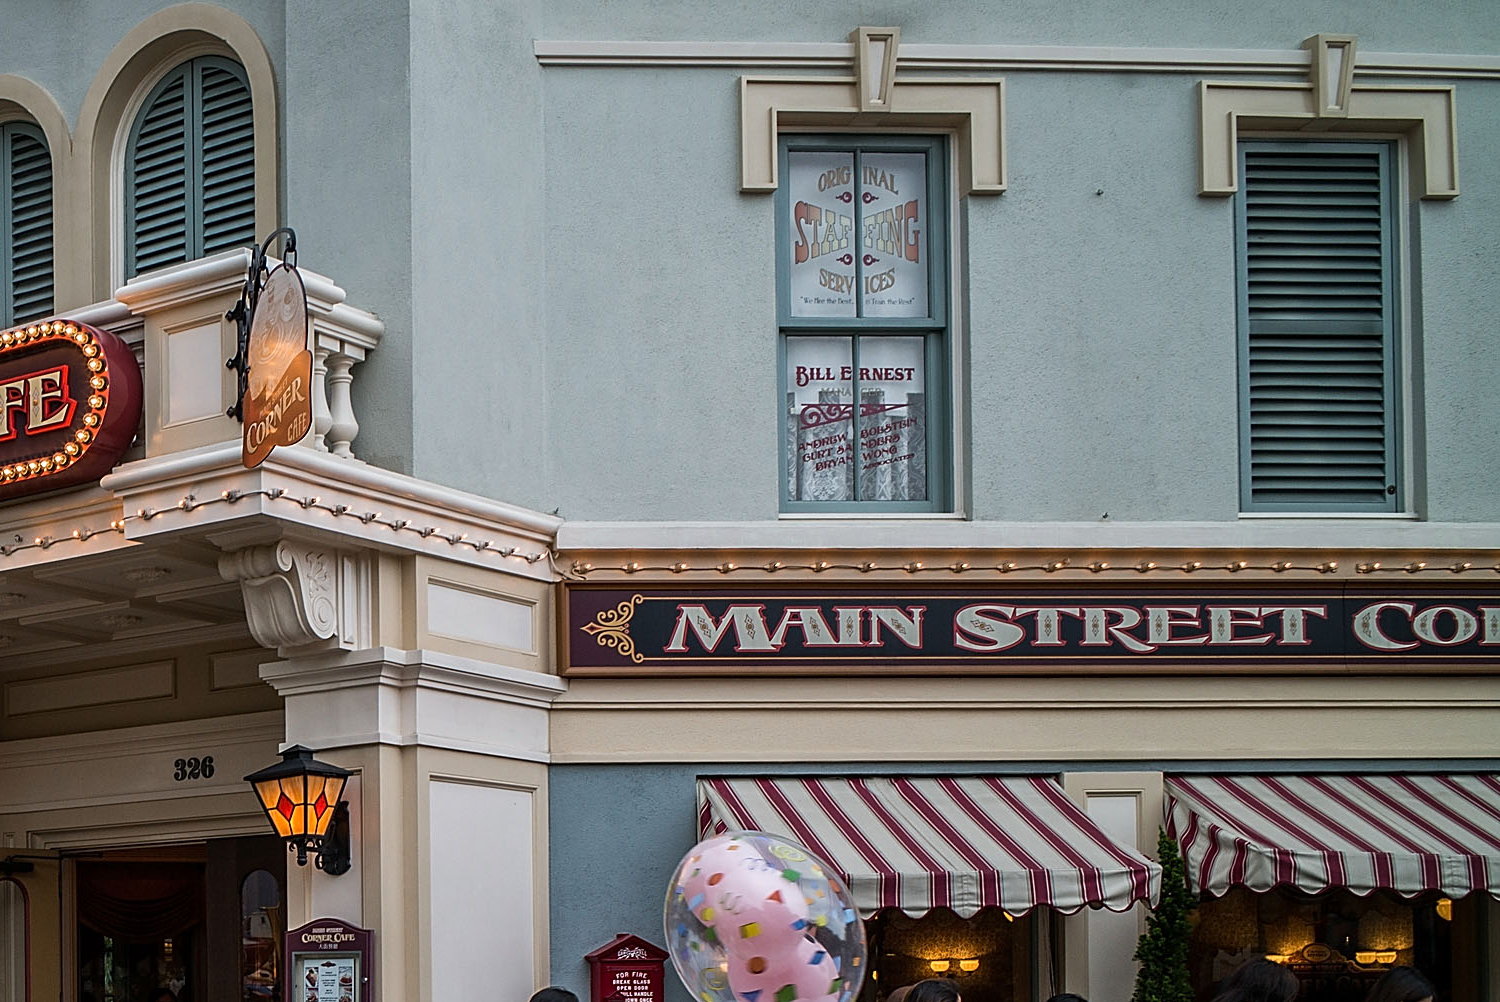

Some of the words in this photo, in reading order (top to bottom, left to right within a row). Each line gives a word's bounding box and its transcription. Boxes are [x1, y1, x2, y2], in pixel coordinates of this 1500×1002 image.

[818, 166, 898, 195] ORIGINAL
[794, 199, 920, 264] STAFFING
[819, 267, 895, 295] SERVICES
[796, 366, 835, 387] BILL
[841, 367, 915, 381] ERNEST
[247, 377, 305, 454] CORNER
[288, 412, 306, 441] CAFE
[798, 431, 848, 452] ANDREW
[815, 456, 854, 471] BRYAN
[862, 445, 898, 461] WONG
[664, 602, 927, 654] MAIN
[954, 602, 1329, 655] STREET
[174, 756, 214, 781] 326
